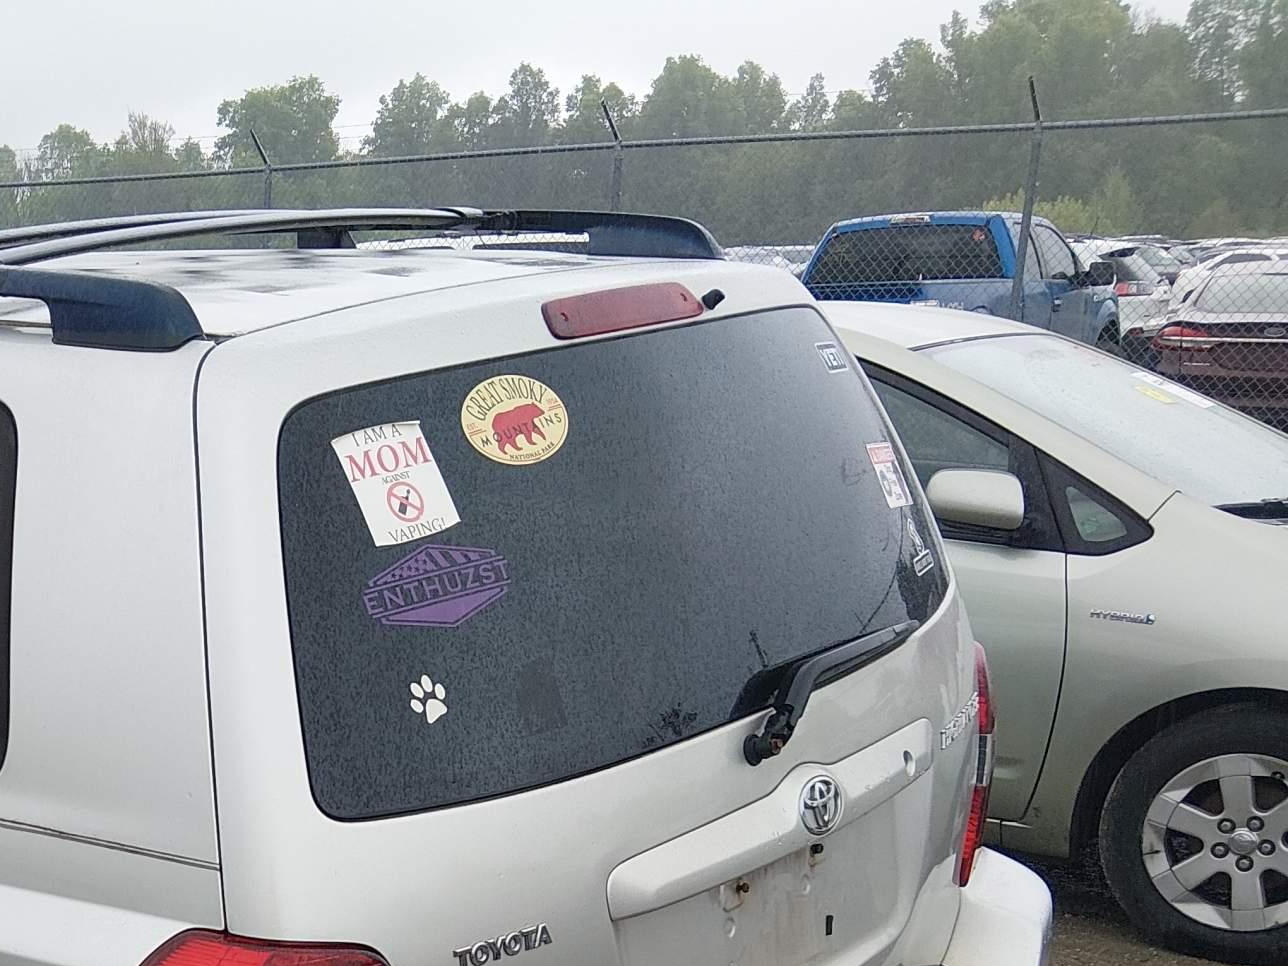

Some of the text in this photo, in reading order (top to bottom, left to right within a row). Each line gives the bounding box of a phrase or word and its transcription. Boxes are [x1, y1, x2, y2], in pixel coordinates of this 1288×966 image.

[466, 377, 546, 421] GREAT SMOKY
[353, 424, 402, 447] I AM A
[480, 413, 562, 448] MOUNTAINS
[344, 437, 432, 483] MOM
[509, 442, 555, 461] NATIONAL PARK
[381, 471, 410, 485] AGAINST
[388, 517, 447, 543] VAPING!
[363, 560, 508, 615] ENTHUZST
